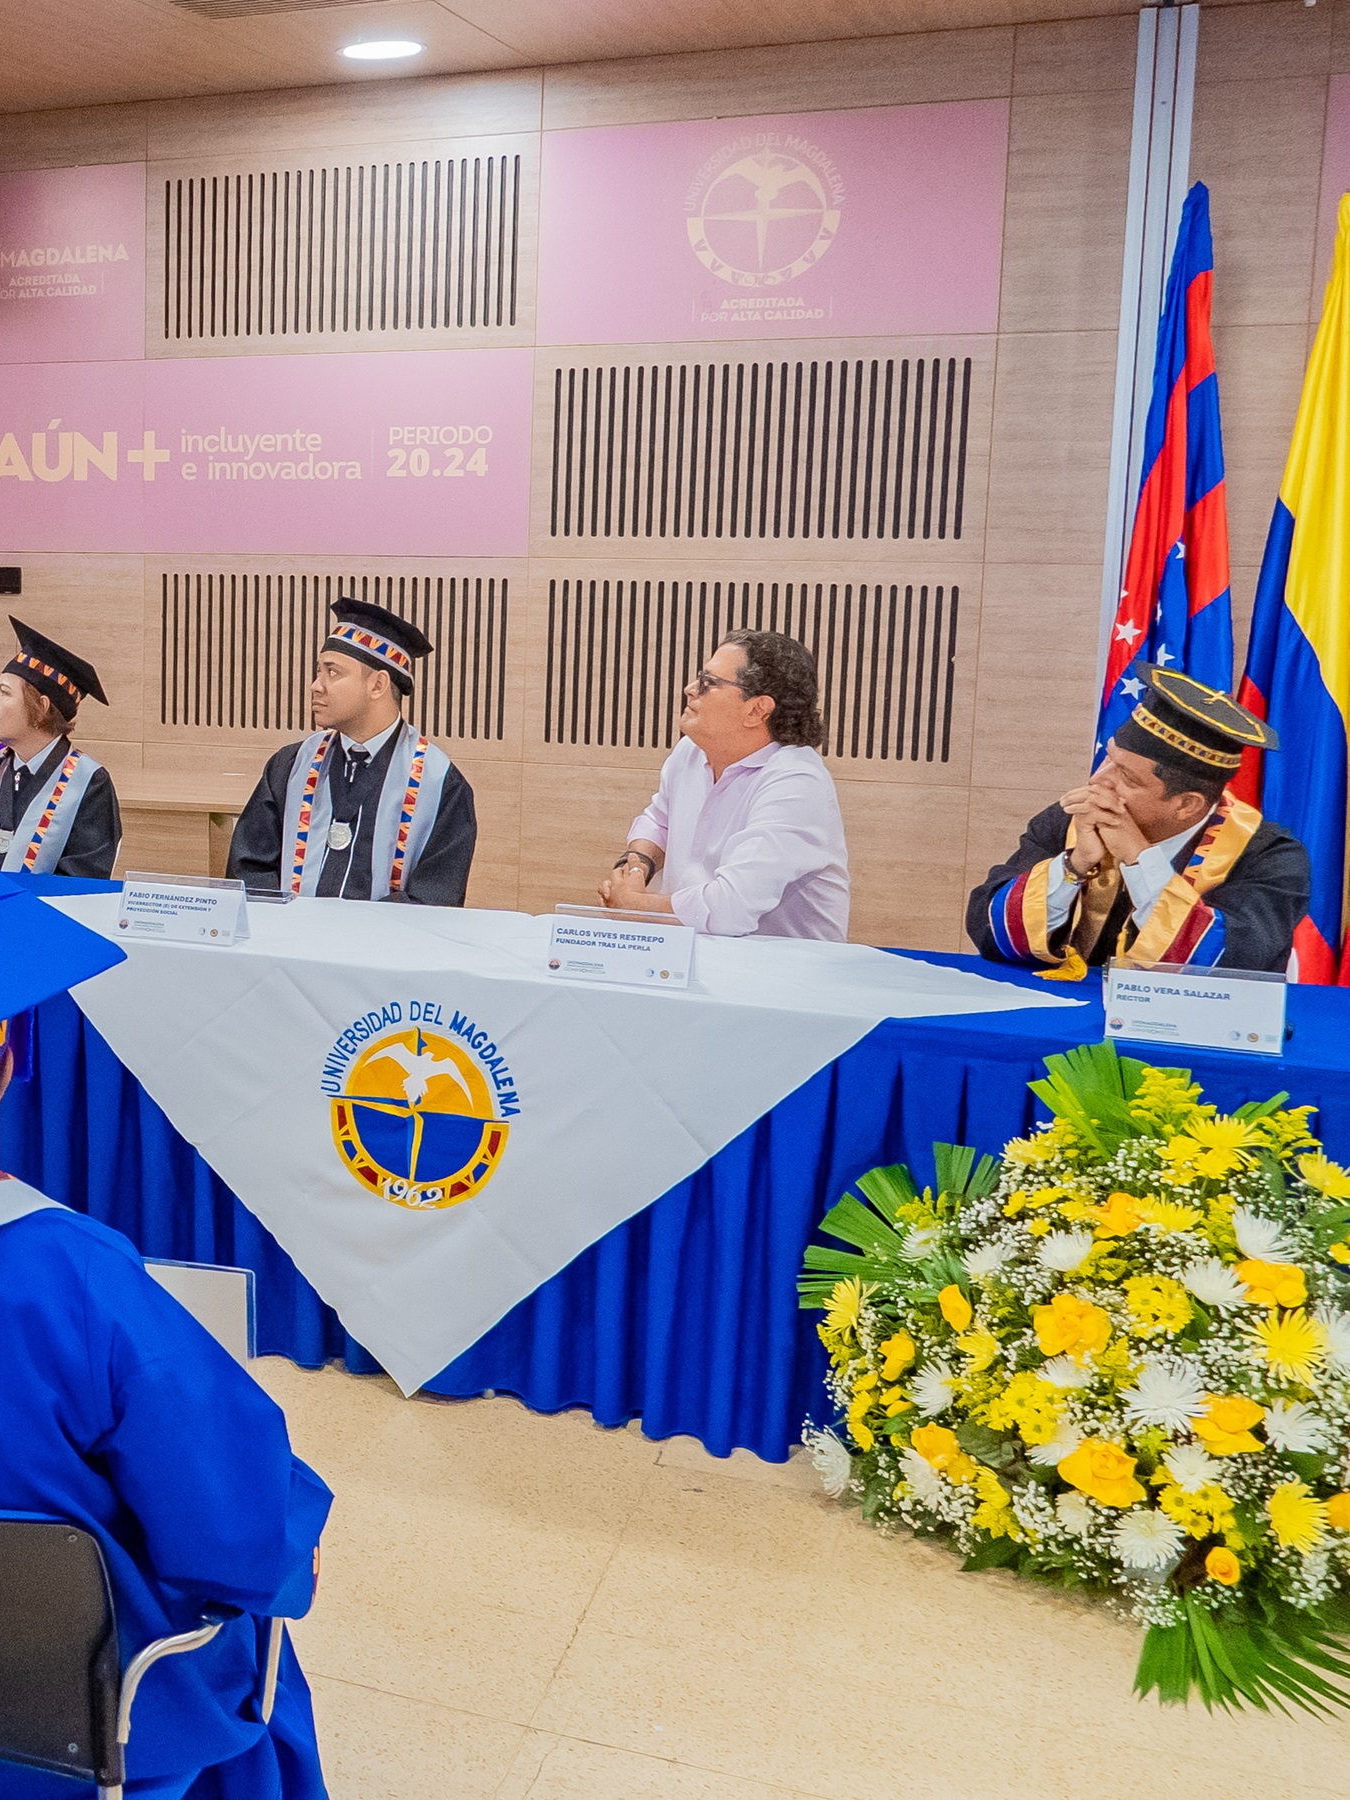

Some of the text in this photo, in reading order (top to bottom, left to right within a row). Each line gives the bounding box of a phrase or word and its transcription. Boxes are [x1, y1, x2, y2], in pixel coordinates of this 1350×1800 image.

[682, 132, 846, 212] UNIVERSIDAD DEL MAGDALENA
[9, 273, 81, 287] ACREDITADA
[19, 288, 45, 299] ALTA
[46, 285, 97, 297] CALIDAD
[721, 297, 806, 310] ACREDITADA
[701, 309, 825, 323] POR ALTA CALIDAD
[180, 426, 323, 460] incluyente
[389, 425, 494, 445] PERIODO
[181, 453, 362, 481] e innovadora
[386, 447, 489, 477] 20.24
[129, 891, 218, 906] FABIO FERNÁNDEZ PINTO
[556, 928, 665, 944] CARLOS VIVES RESTREPO
[555, 938, 597, 947] FUNDADOR
[598, 941, 617, 949] TRAS
[628, 944, 651, 952] PERLA
[1116, 983, 1231, 1000] PABLO VERA SALAZAR
[1116, 994, 1151, 1003] RECTOR
[320, 1000, 521, 1118] UNIVERSIDAD DEL MAGDALENA
[381, 1176, 443, 1209] 1962
